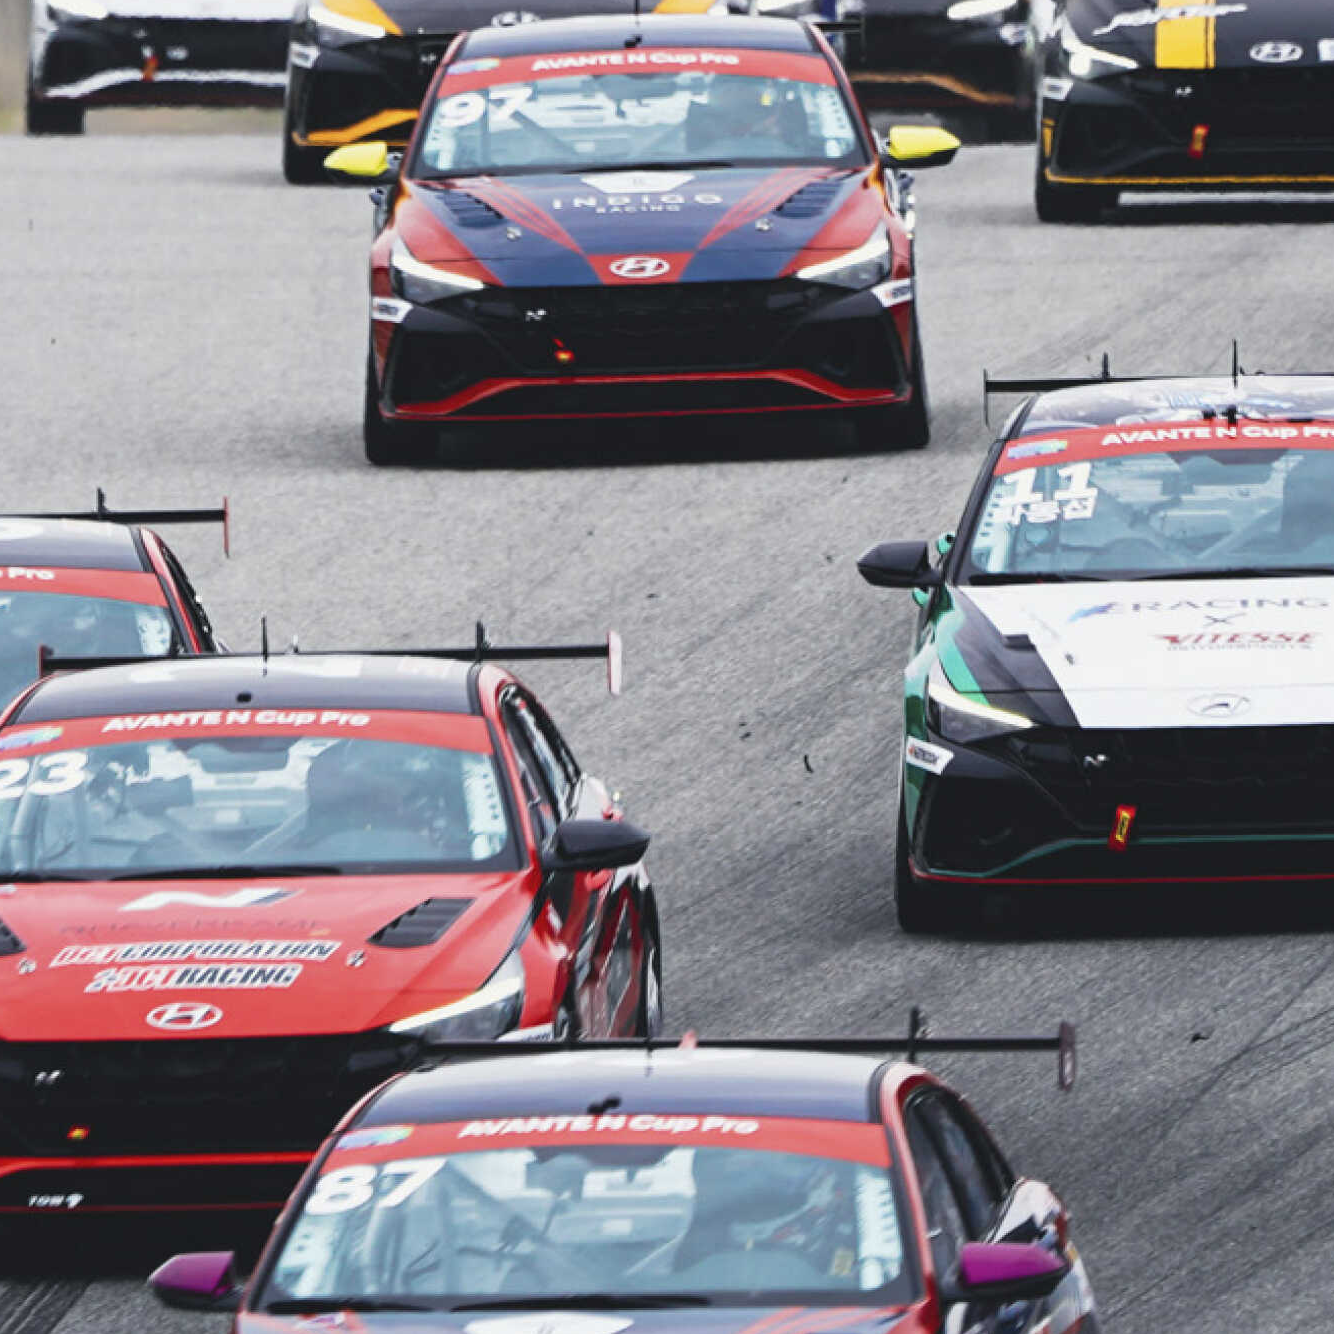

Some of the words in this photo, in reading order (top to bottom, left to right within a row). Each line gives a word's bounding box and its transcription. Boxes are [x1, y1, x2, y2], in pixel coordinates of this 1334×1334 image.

[532, 54, 623, 72] AVANTE
[627, 53, 646, 66] N
[650, 52, 697, 67] Cup
[700, 52, 740, 66] Pro
[438, 86, 533, 127] 97
[1101, 427, 1213, 447] AVANTE
[1216, 425, 1237, 440] N
[1241, 425, 1299, 440] Cup
[997, 461, 1098, 505] 11
[8, 567, 55, 581] Pro
[102, 713, 223, 733] AVANTE
[226, 711, 251, 726] N
[255, 710, 315, 727] Cup
[320, 711, 369, 727] Pro
[459, 1117, 593, 1139] AVANTE
[597, 1115, 622, 1131] N
[628, 1115, 698, 1134] Cup
[703, 1117, 759, 1135] Pro
[306, 1158, 448, 1215] 87
